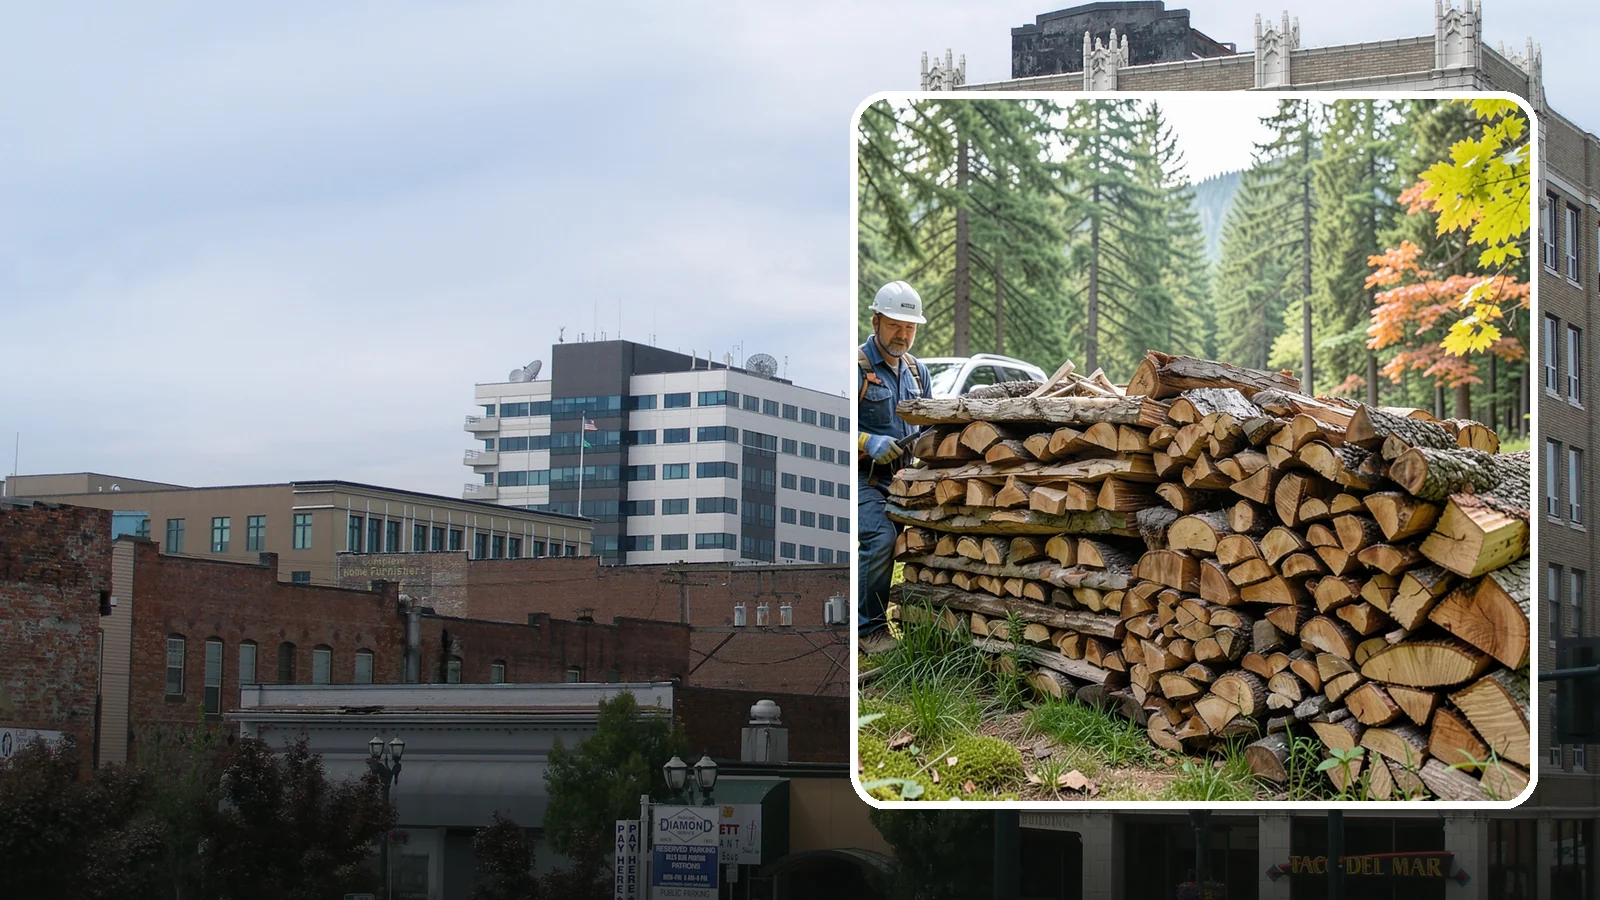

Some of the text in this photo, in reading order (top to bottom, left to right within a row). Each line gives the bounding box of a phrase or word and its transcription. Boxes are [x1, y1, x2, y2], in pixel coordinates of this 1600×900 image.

[343, 566, 427, 577] Home Furnishers
[660, 818, 713, 832] DIAMOND
[1021, 815, 1070, 828] BUILDING
[616, 825, 625, 893] PAY HERE
[627, 825, 637, 893] PAY HERE
[721, 851, 739, 863] Soup
[671, 862, 701, 870] PATRONS
[1346, 856, 1385, 876] DEL
[1392, 857, 1443, 877] MAR
[660, 888, 710, 898] PUBLIC PARKING
